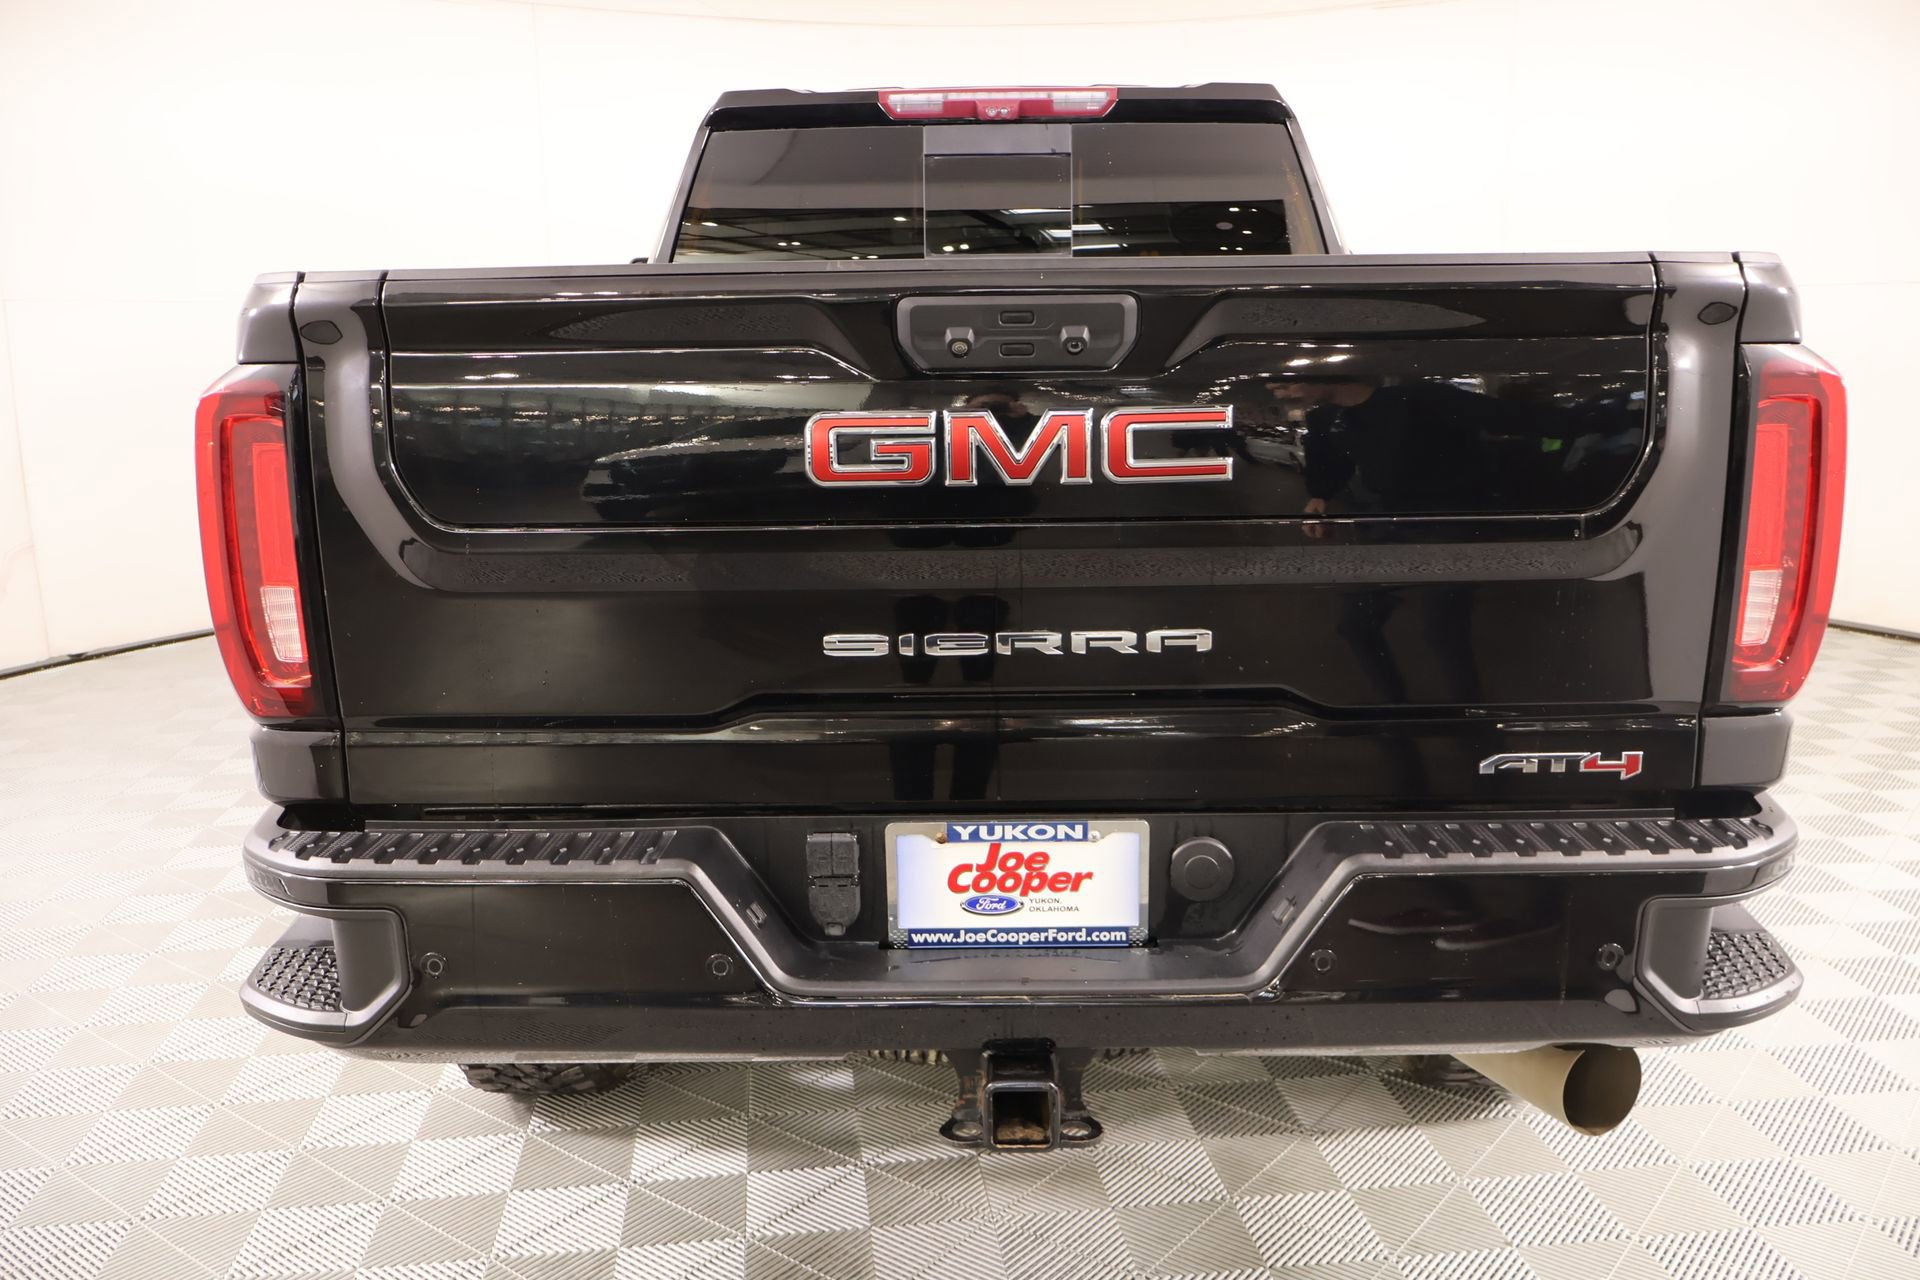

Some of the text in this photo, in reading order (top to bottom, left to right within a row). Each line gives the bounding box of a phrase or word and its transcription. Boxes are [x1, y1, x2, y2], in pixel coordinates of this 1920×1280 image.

[804, 404, 1234, 488] GMC
[822, 628, 1213, 657] SIERRA
[1479, 751, 1644, 780] AT4
[952, 824, 1084, 841] YUKON
[976, 842, 1050, 874] Joe
[947, 863, 1093, 897] Cooper
[975, 897, 1007, 910] Ford
[911, 928, 1127, 945] www.JoeCooperFord.com
